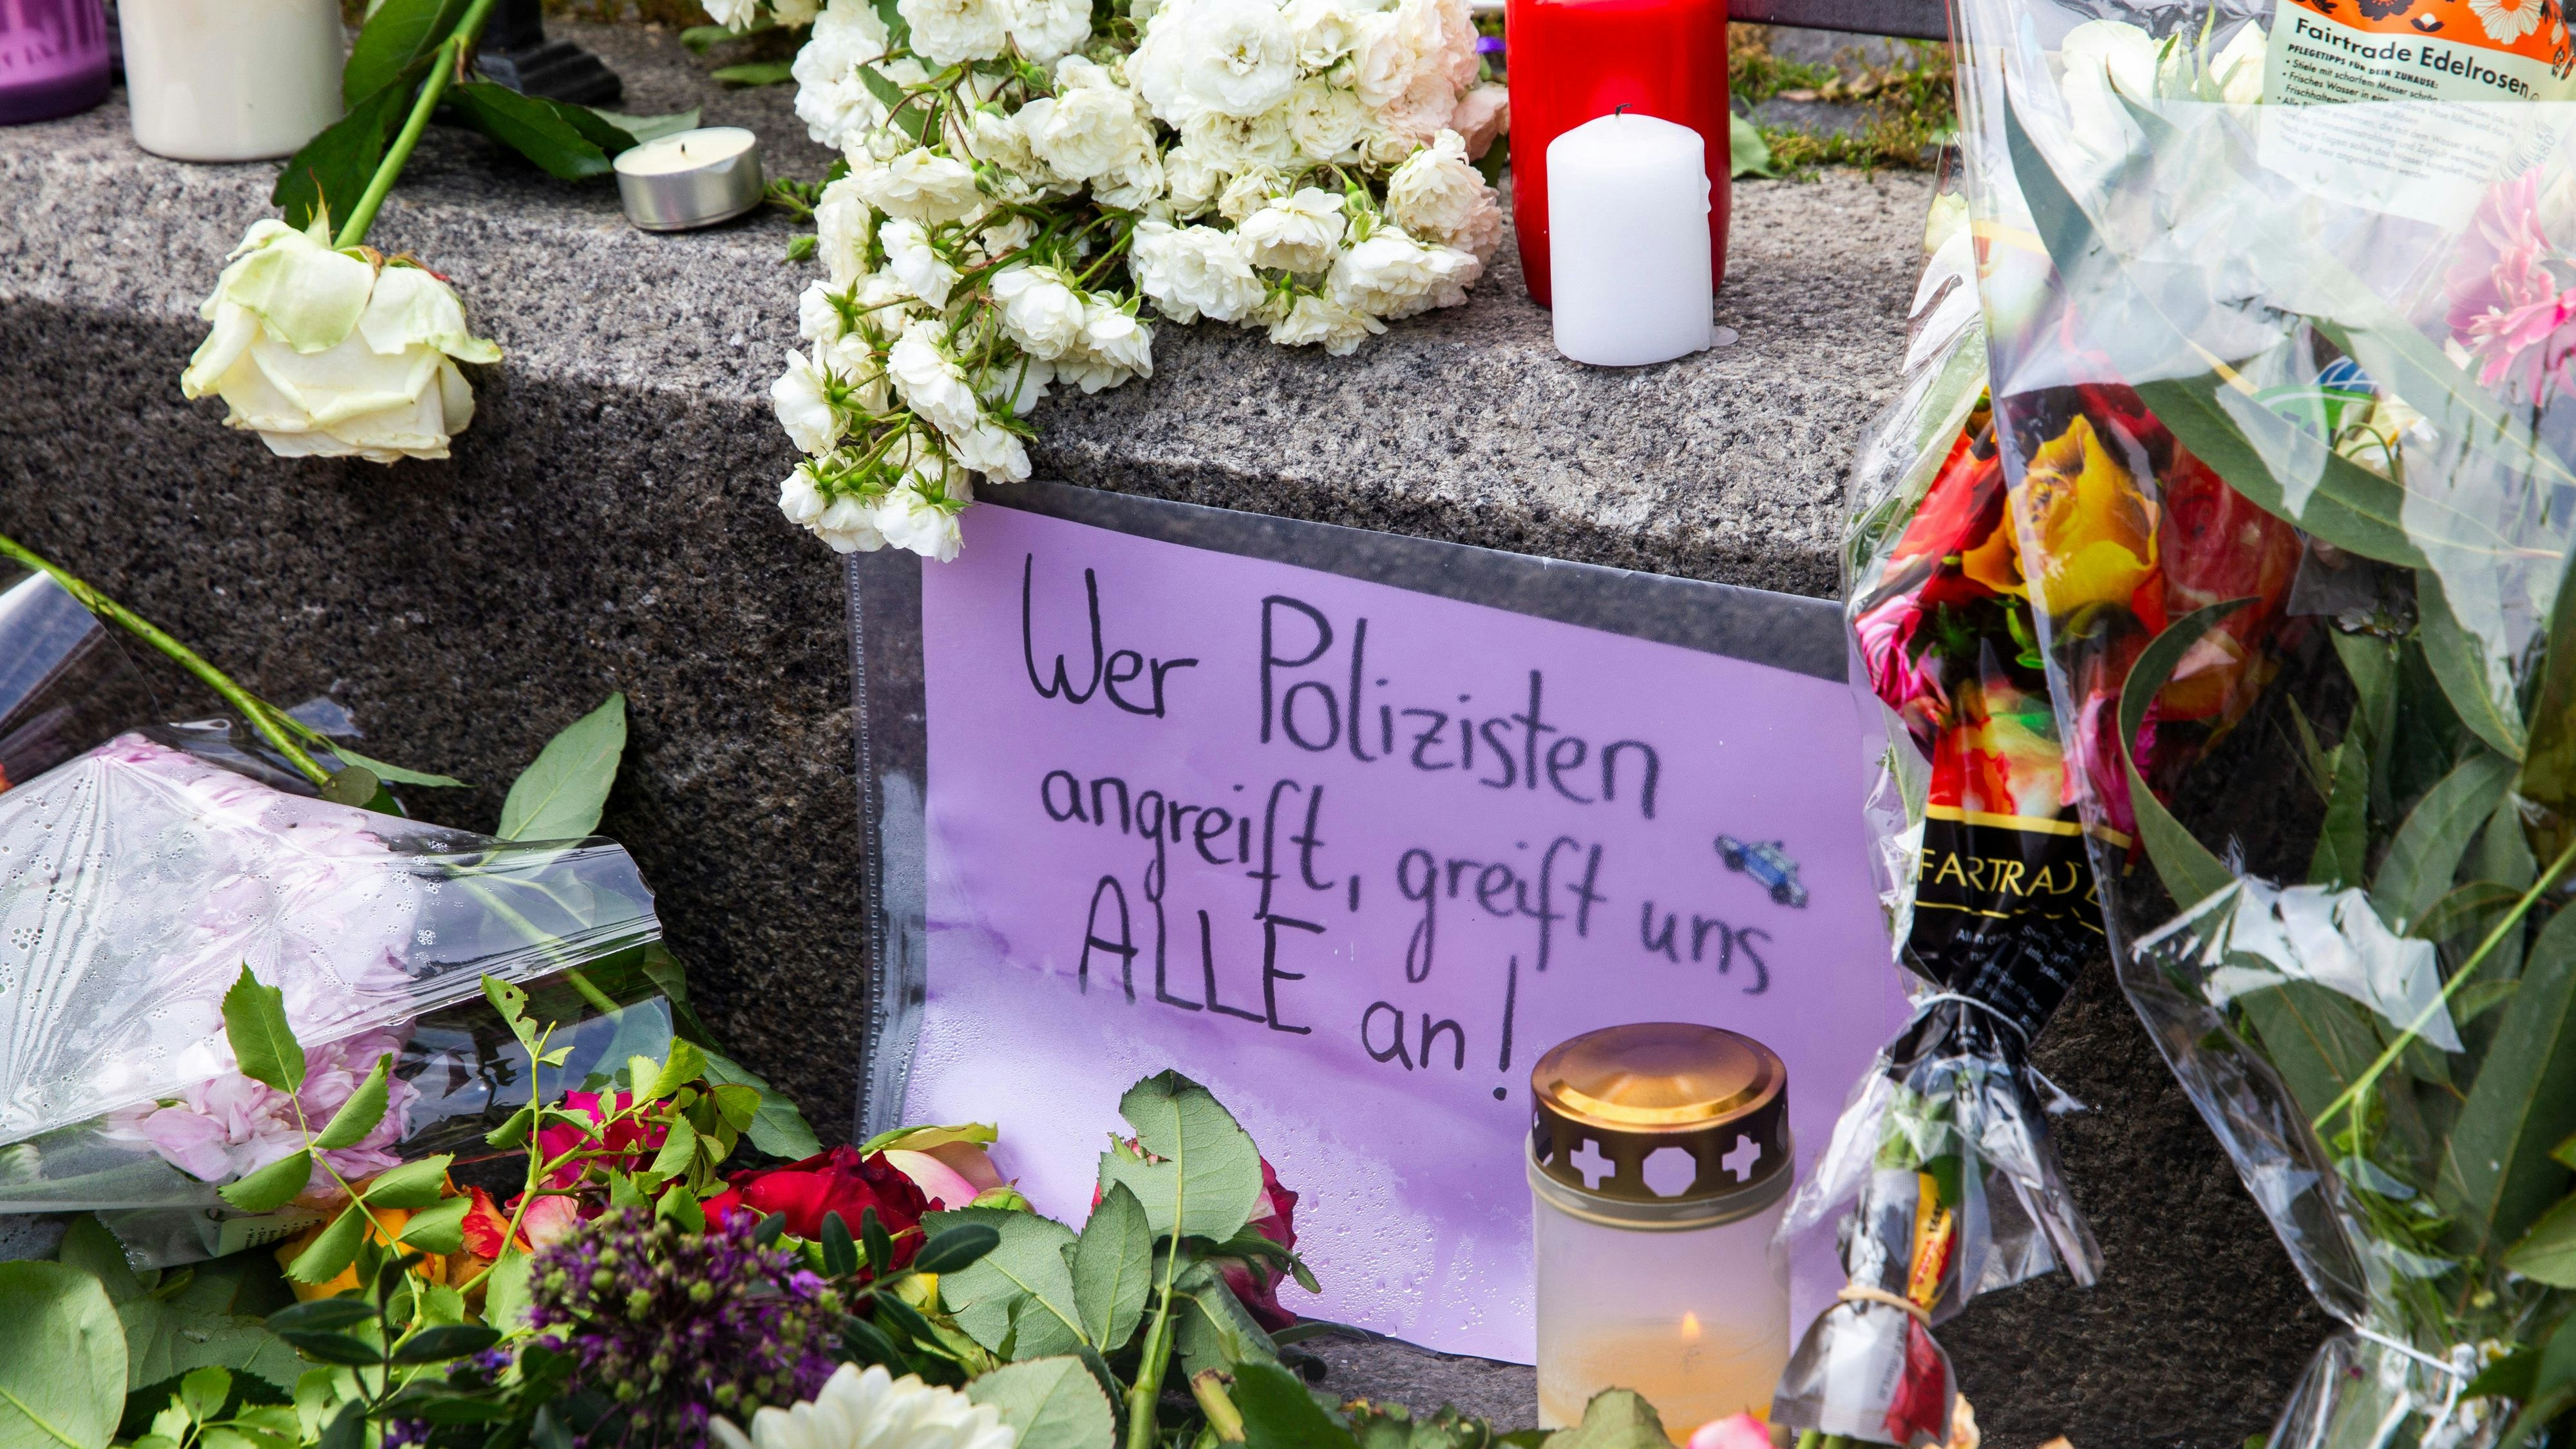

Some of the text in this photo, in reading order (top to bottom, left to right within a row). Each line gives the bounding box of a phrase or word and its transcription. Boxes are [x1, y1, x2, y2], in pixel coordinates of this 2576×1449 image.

[2288, 44, 2345, 64] PFLEGETIPPS
[2396, 71, 2439, 89] ZUHAUSE:
[2289, 71, 2324, 88] Frisches
[2327, 81, 2359, 96] Wasser
[2361, 90, 2369, 99] in
[2293, 59, 2316, 72] Stiele
[2319, 64, 2333, 76] mit
[2334, 71, 2375, 88] scharfem
[2378, 82, 2408, 95] Messer
[2296, 17, 2530, 99] Fairtrade Edelrosen
[1024, 553, 1659, 819] Wer Polizisten
[1041, 770, 1771, 996] angreift, greift uns
[1079, 875, 1518, 1102] ALLE an!
